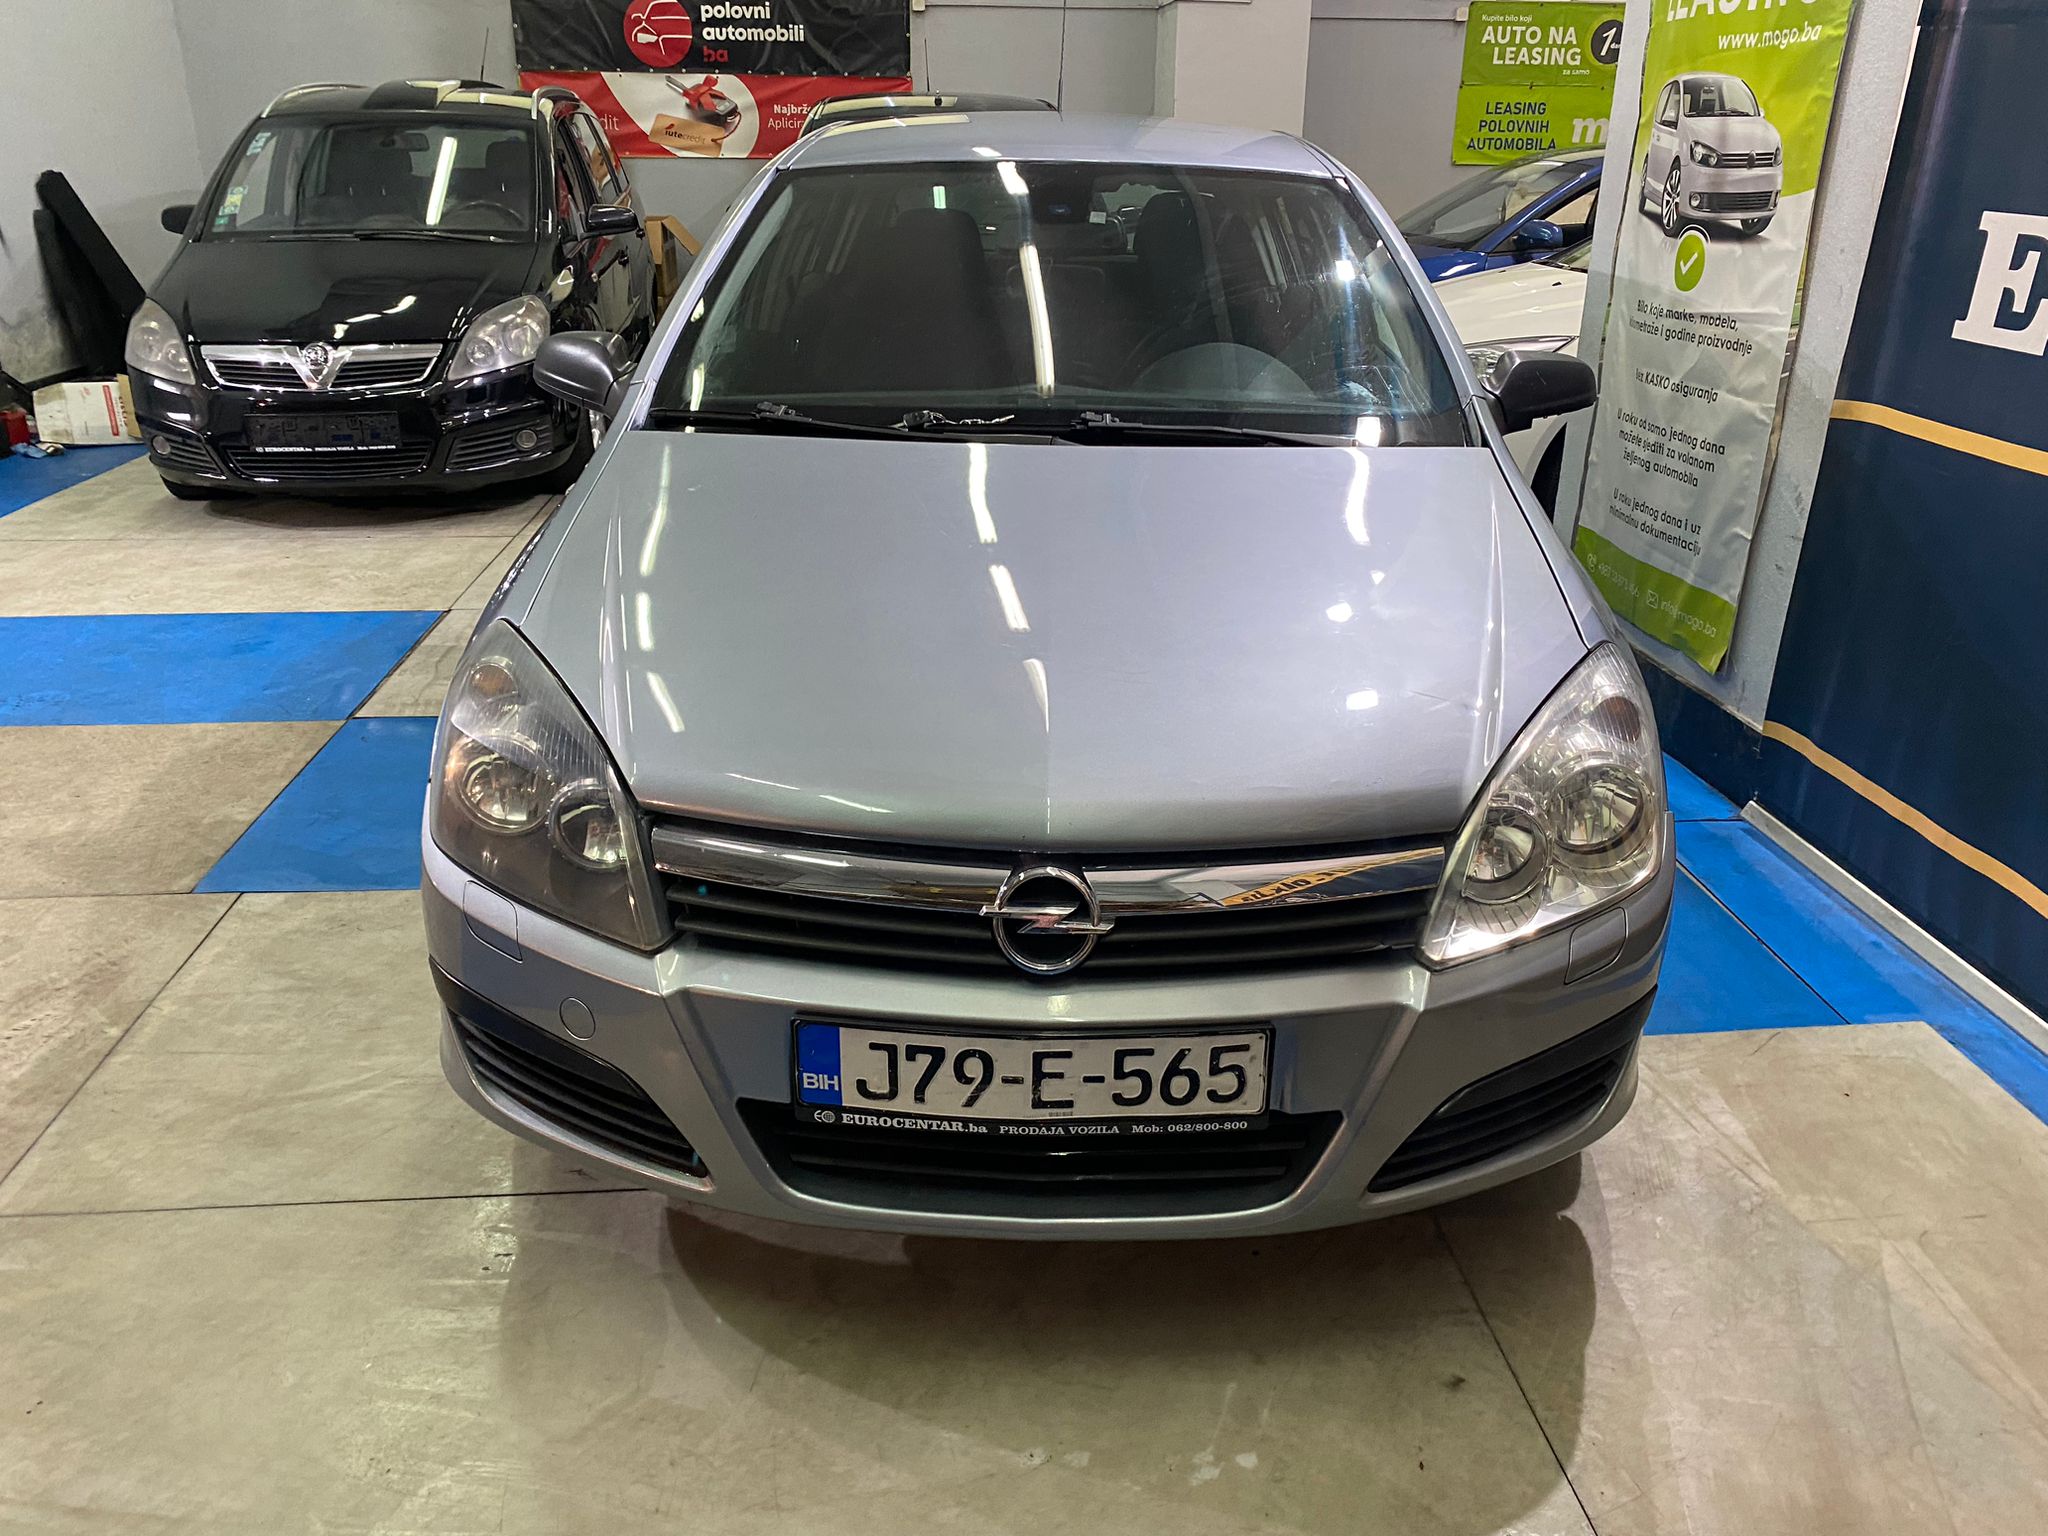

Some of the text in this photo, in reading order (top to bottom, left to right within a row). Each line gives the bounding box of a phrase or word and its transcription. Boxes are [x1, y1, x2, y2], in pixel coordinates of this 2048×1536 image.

[701, 2, 771, 22] polovni
[1482, 14, 1533, 23] Kupite bilo koji
[702, 24, 805, 42] automobili
[1481, 26, 1578, 45] AUTO NA
[1600, 27, 1617, 56] 1
[1718, 21, 1823, 50] www.mogo.ba
[1492, 47, 1582, 66] LEASING
[1486, 101, 1547, 115] LEASING
[1479, 120, 1549, 133] POLOVNIH
[1467, 137, 1557, 151] AUTOMOBILA
[1649, 303, 1663, 319] koje
[1699, 314, 1739, 332] modela,
[1665, 328, 1696, 341] godine
[1697, 333, 1753, 357] proizvodnje
[1644, 371, 1671, 390] KASKO
[1671, 381, 1718, 404] osiguranja
[1617, 408, 1725, 455] U roku od samo jednog dana
[1623, 447, 1698, 487] željenog automobila
[1642, 437, 1665, 456] sjediti
[1666, 447, 1675, 459] za
[1678, 452, 1715, 472] volanom
[1613, 487, 1619, 499] U
[1631, 497, 1659, 522] jednog
[1660, 510, 1682, 529] dana
[1684, 518, 1688, 531] i
[1690, 523, 1701, 535] uz
[1640, 520, 1701, 557] dokumentaciju
[802, 1041, 1251, 1109] BIH J79-E-565
[841, 1112, 1248, 1135] EUROCENTAR.ba PRODAJA VOZILA Mob: 062/800-800
